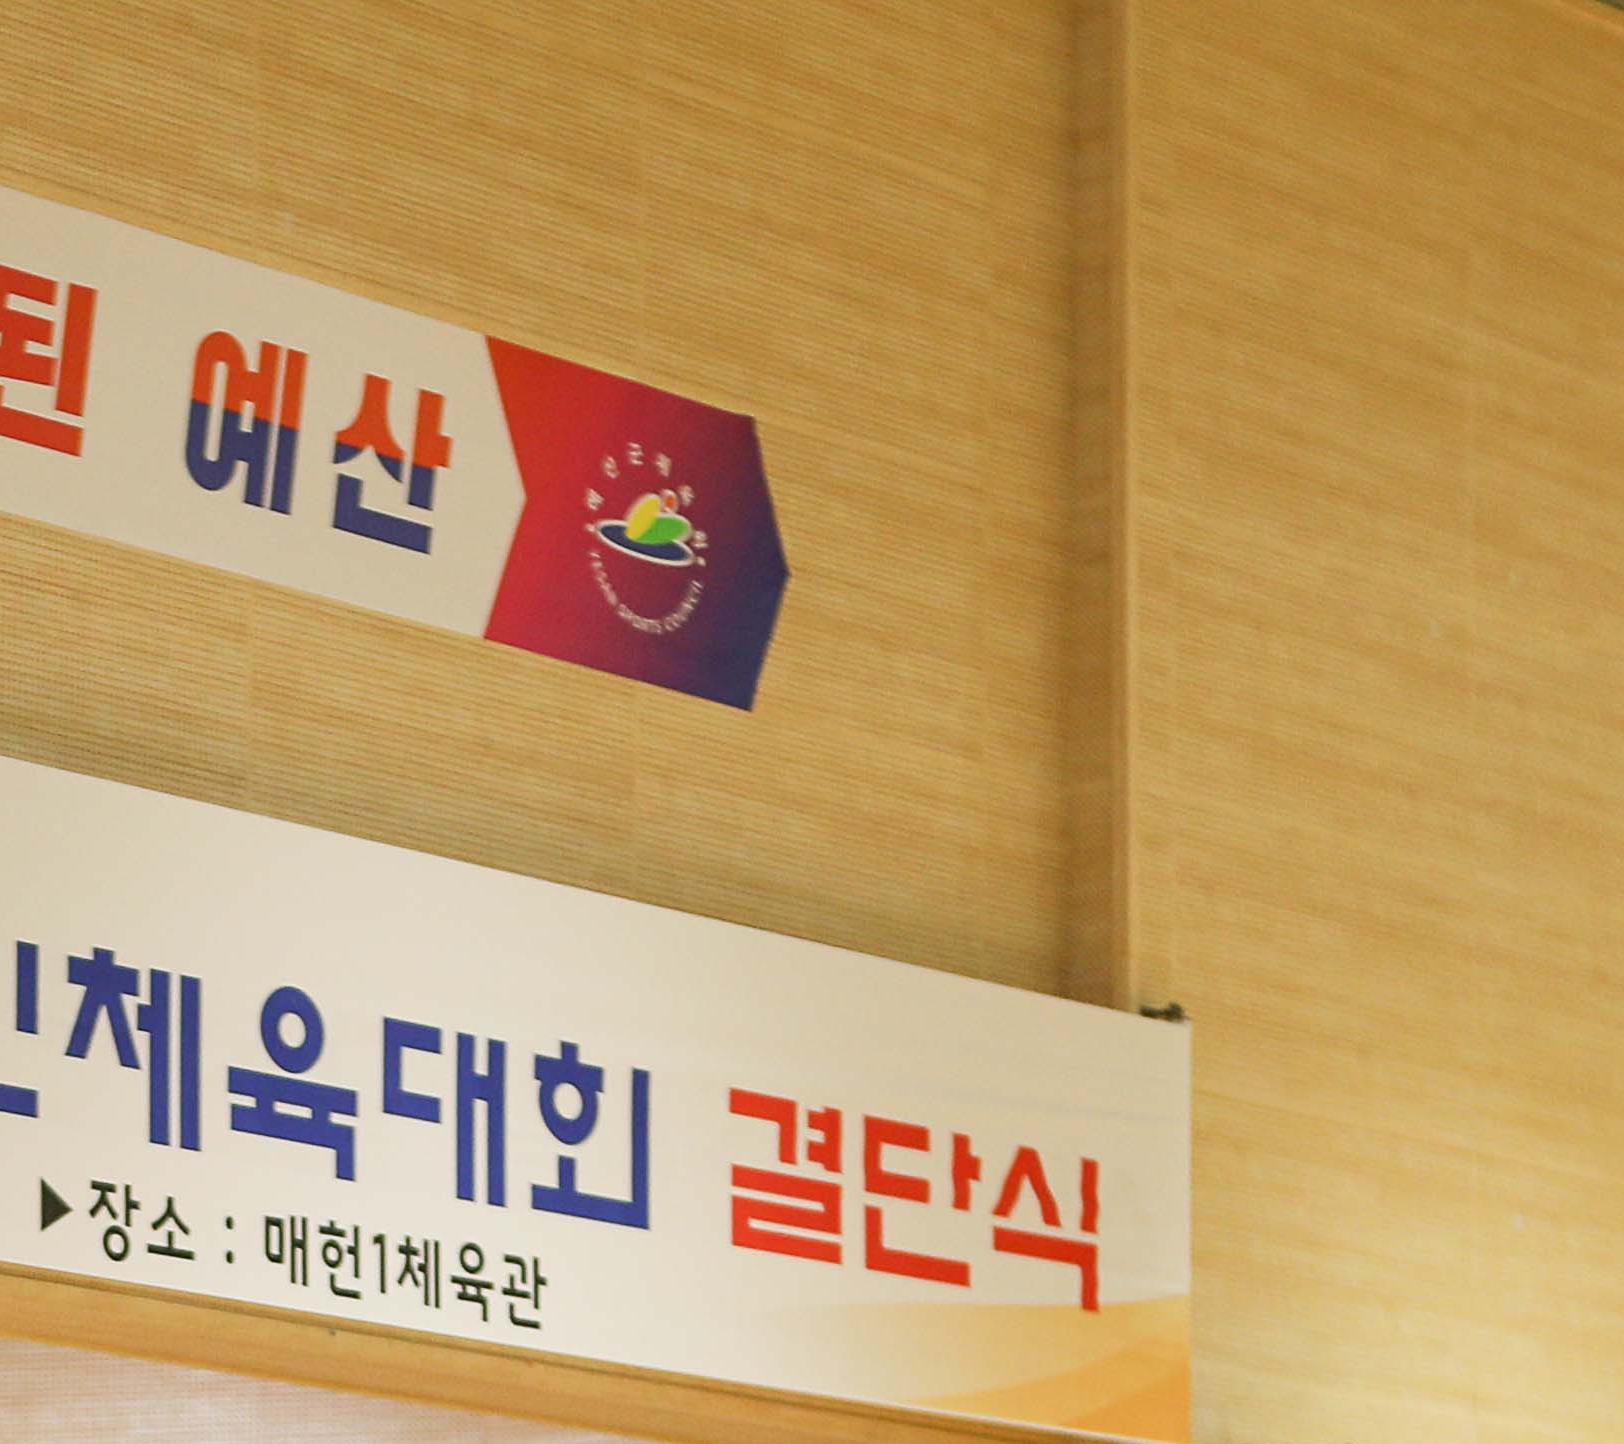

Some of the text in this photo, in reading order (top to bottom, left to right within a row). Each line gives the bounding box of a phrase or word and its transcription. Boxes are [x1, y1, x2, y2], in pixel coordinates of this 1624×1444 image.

[185, 331, 452, 553] 예산
[87, 1178, 196, 1262] 장소
[264, 1213, 547, 1330] 매헌1체육관
[729, 1087, 1100, 1312] 결단식
